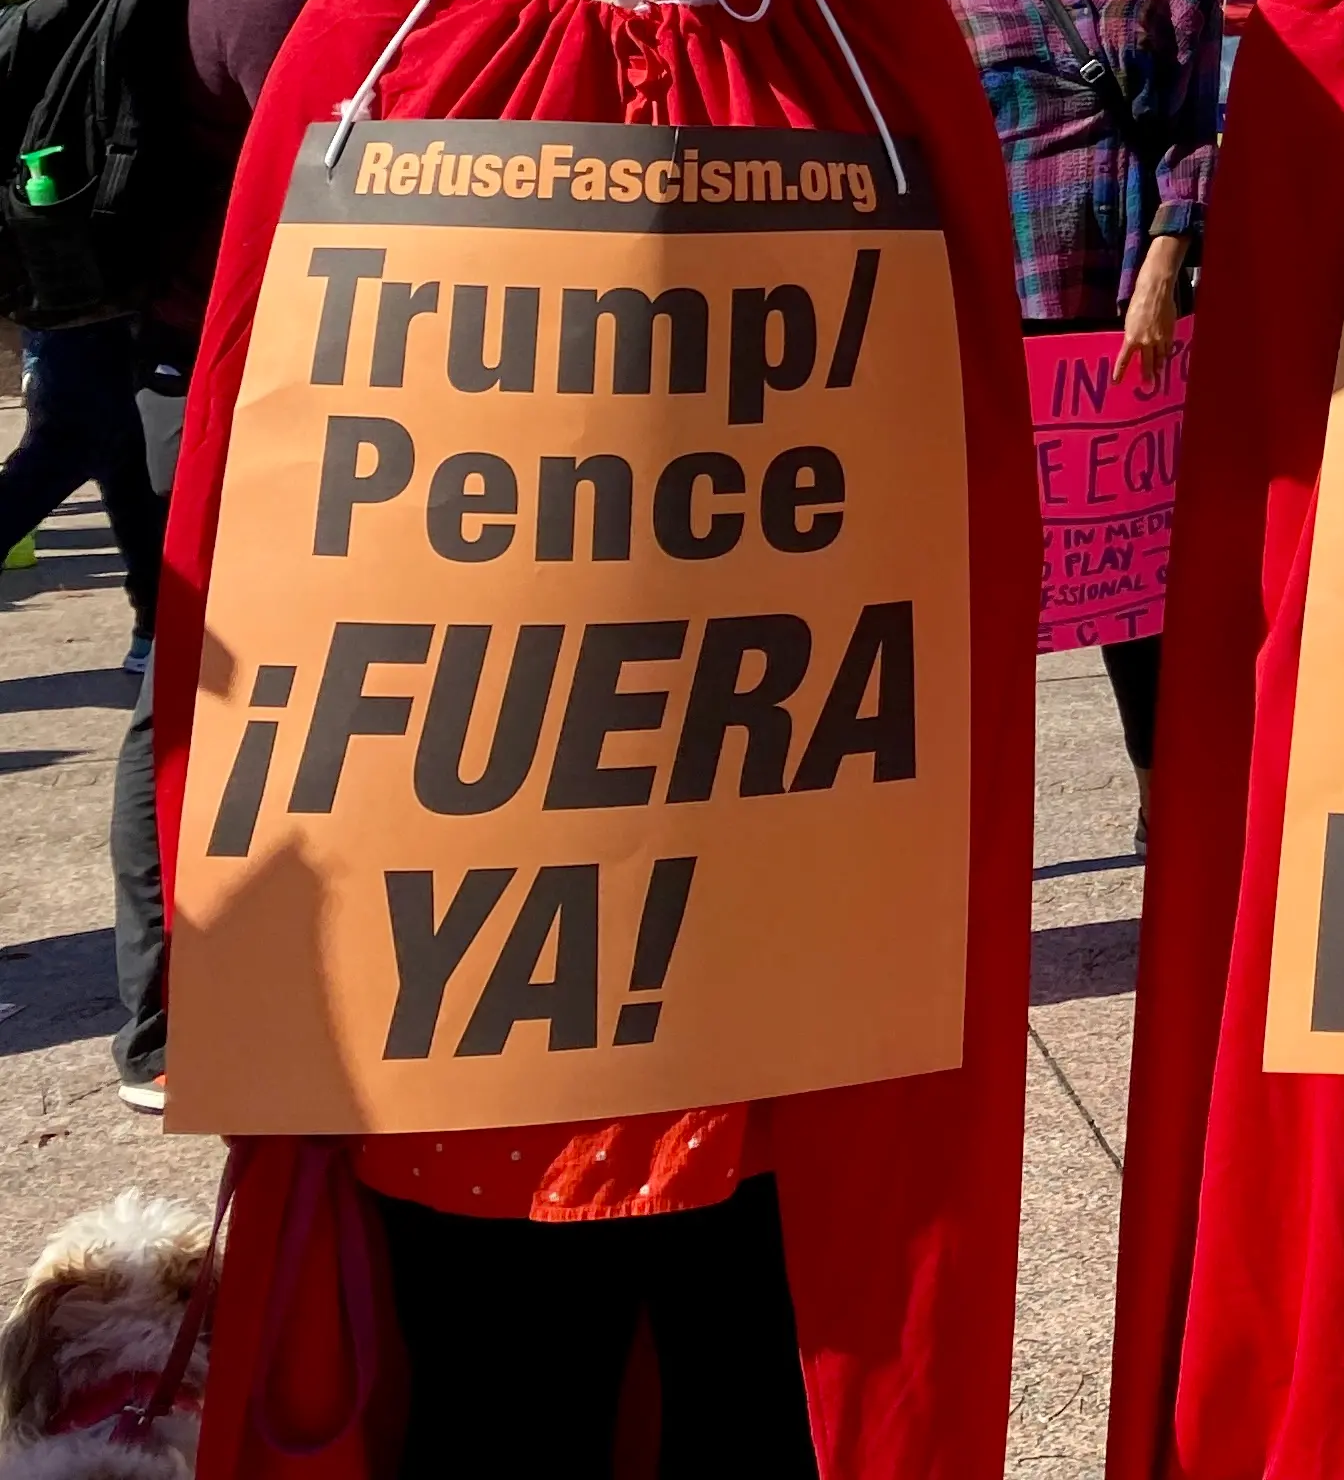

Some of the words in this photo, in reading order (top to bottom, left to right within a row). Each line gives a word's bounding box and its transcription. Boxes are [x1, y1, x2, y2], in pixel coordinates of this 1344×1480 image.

[355, 141, 877, 212] RefuseFascism.org
[306, 246, 881, 425] Trump/
[1051, 356, 1110, 417] IN
[312, 415, 846, 563] Pence
[1086, 421, 1183, 505] EQU
[1063, 527, 1096, 550] IN
[1064, 541, 1135, 578] PLAY
[205, 600, 918, 858] ¡FUERA
[381, 855, 698, 1062] YA!
